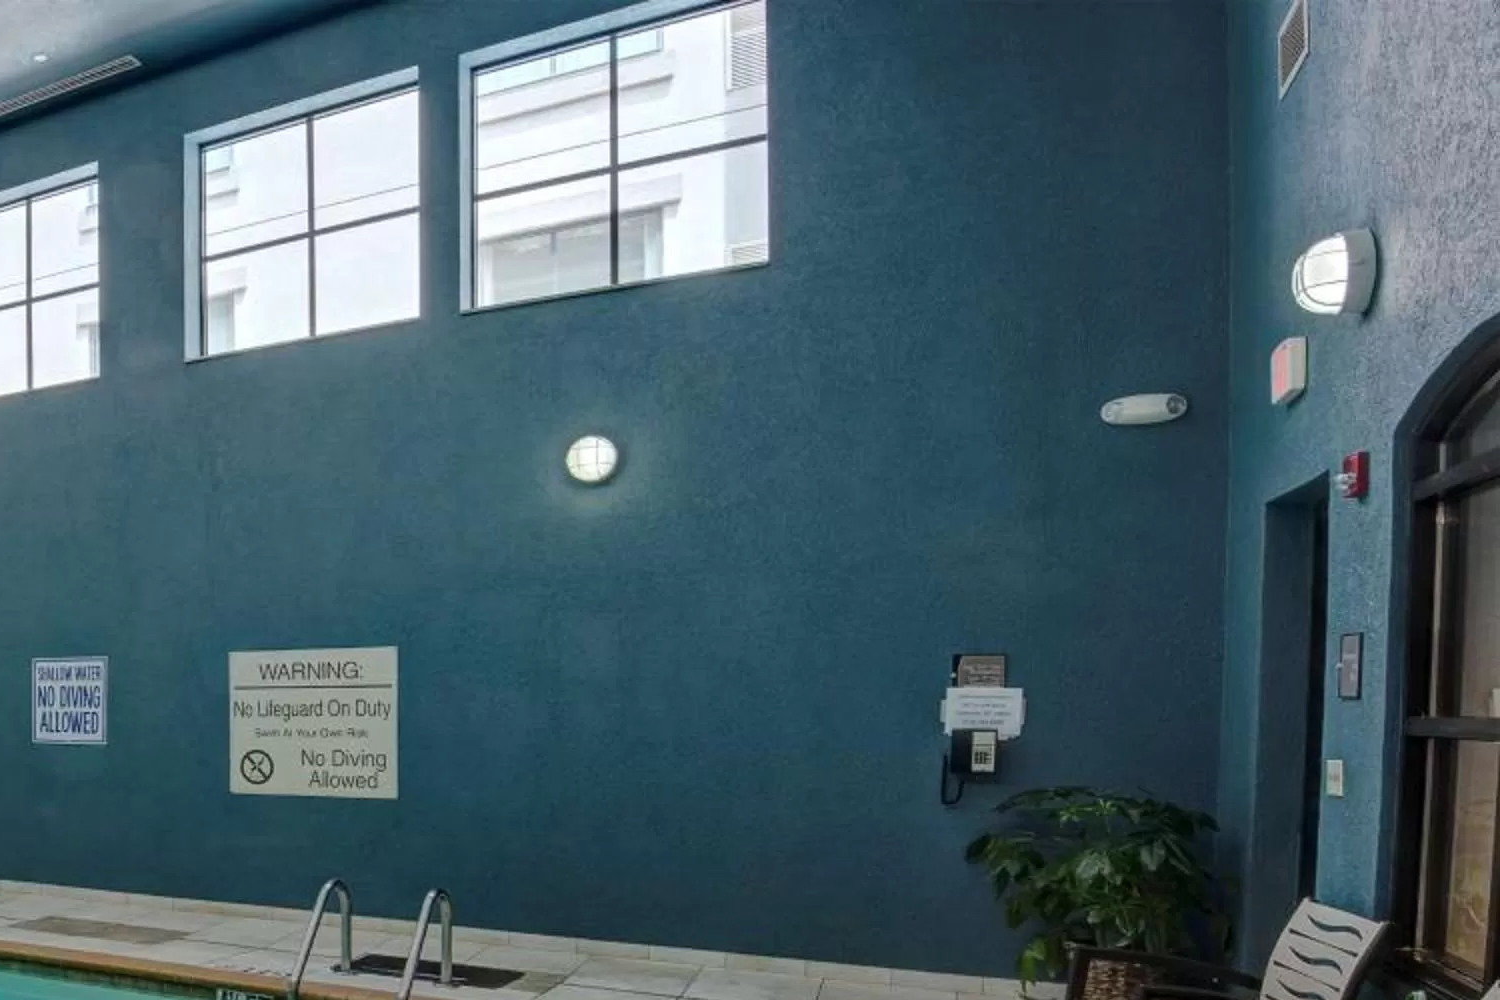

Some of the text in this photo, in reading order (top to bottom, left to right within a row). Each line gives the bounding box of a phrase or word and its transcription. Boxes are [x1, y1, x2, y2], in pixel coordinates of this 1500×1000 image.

[37, 665, 101, 681] SHALLOW WATER
[258, 661, 364, 681] WARNING:
[37, 685, 101, 709] NO DIVING
[233, 698, 392, 722] No Lifeguard On Duty
[40, 711, 99, 734] ALLOWED
[301, 749, 387, 772] No Diving
[308, 769, 379, 789] Allowed
